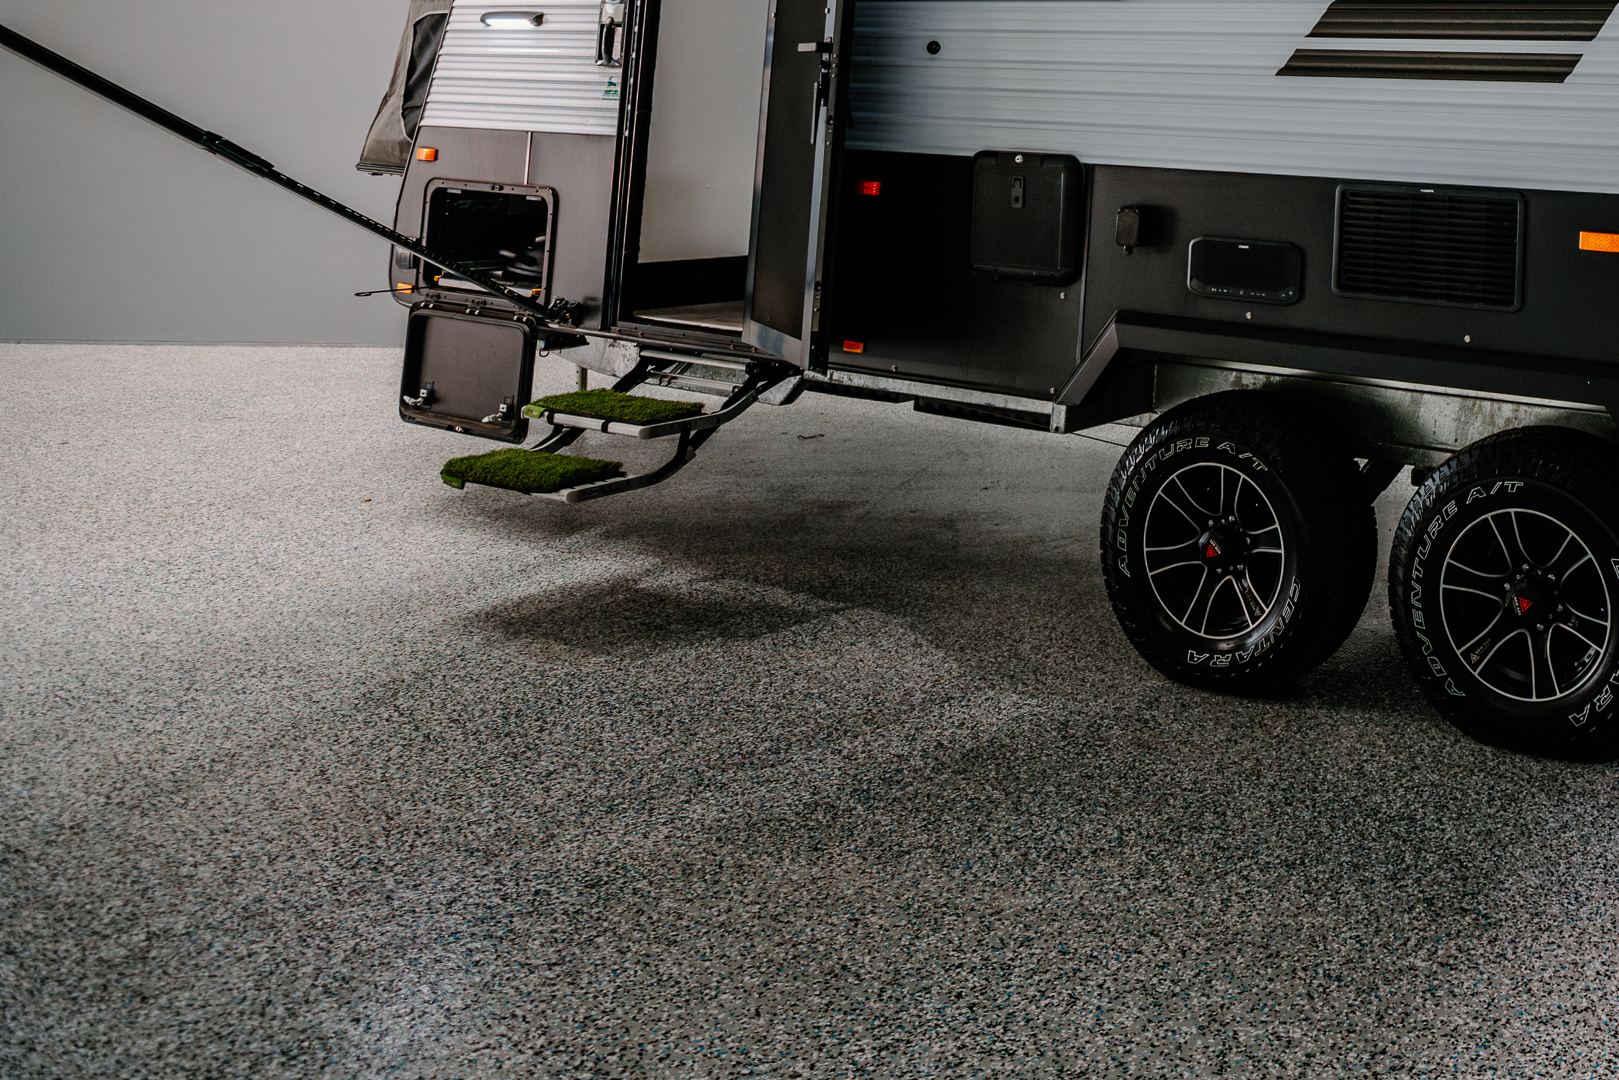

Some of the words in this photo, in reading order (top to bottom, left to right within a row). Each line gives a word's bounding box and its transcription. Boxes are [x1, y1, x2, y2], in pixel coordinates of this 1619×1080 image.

[1116, 436, 1211, 578] ADVENTURE
[1216, 441, 1269, 473] A/T
[1187, 574, 1302, 668] CENTARA
[1410, 499, 1468, 698] ADVENTURE
[1465, 480, 1525, 505] A/T
